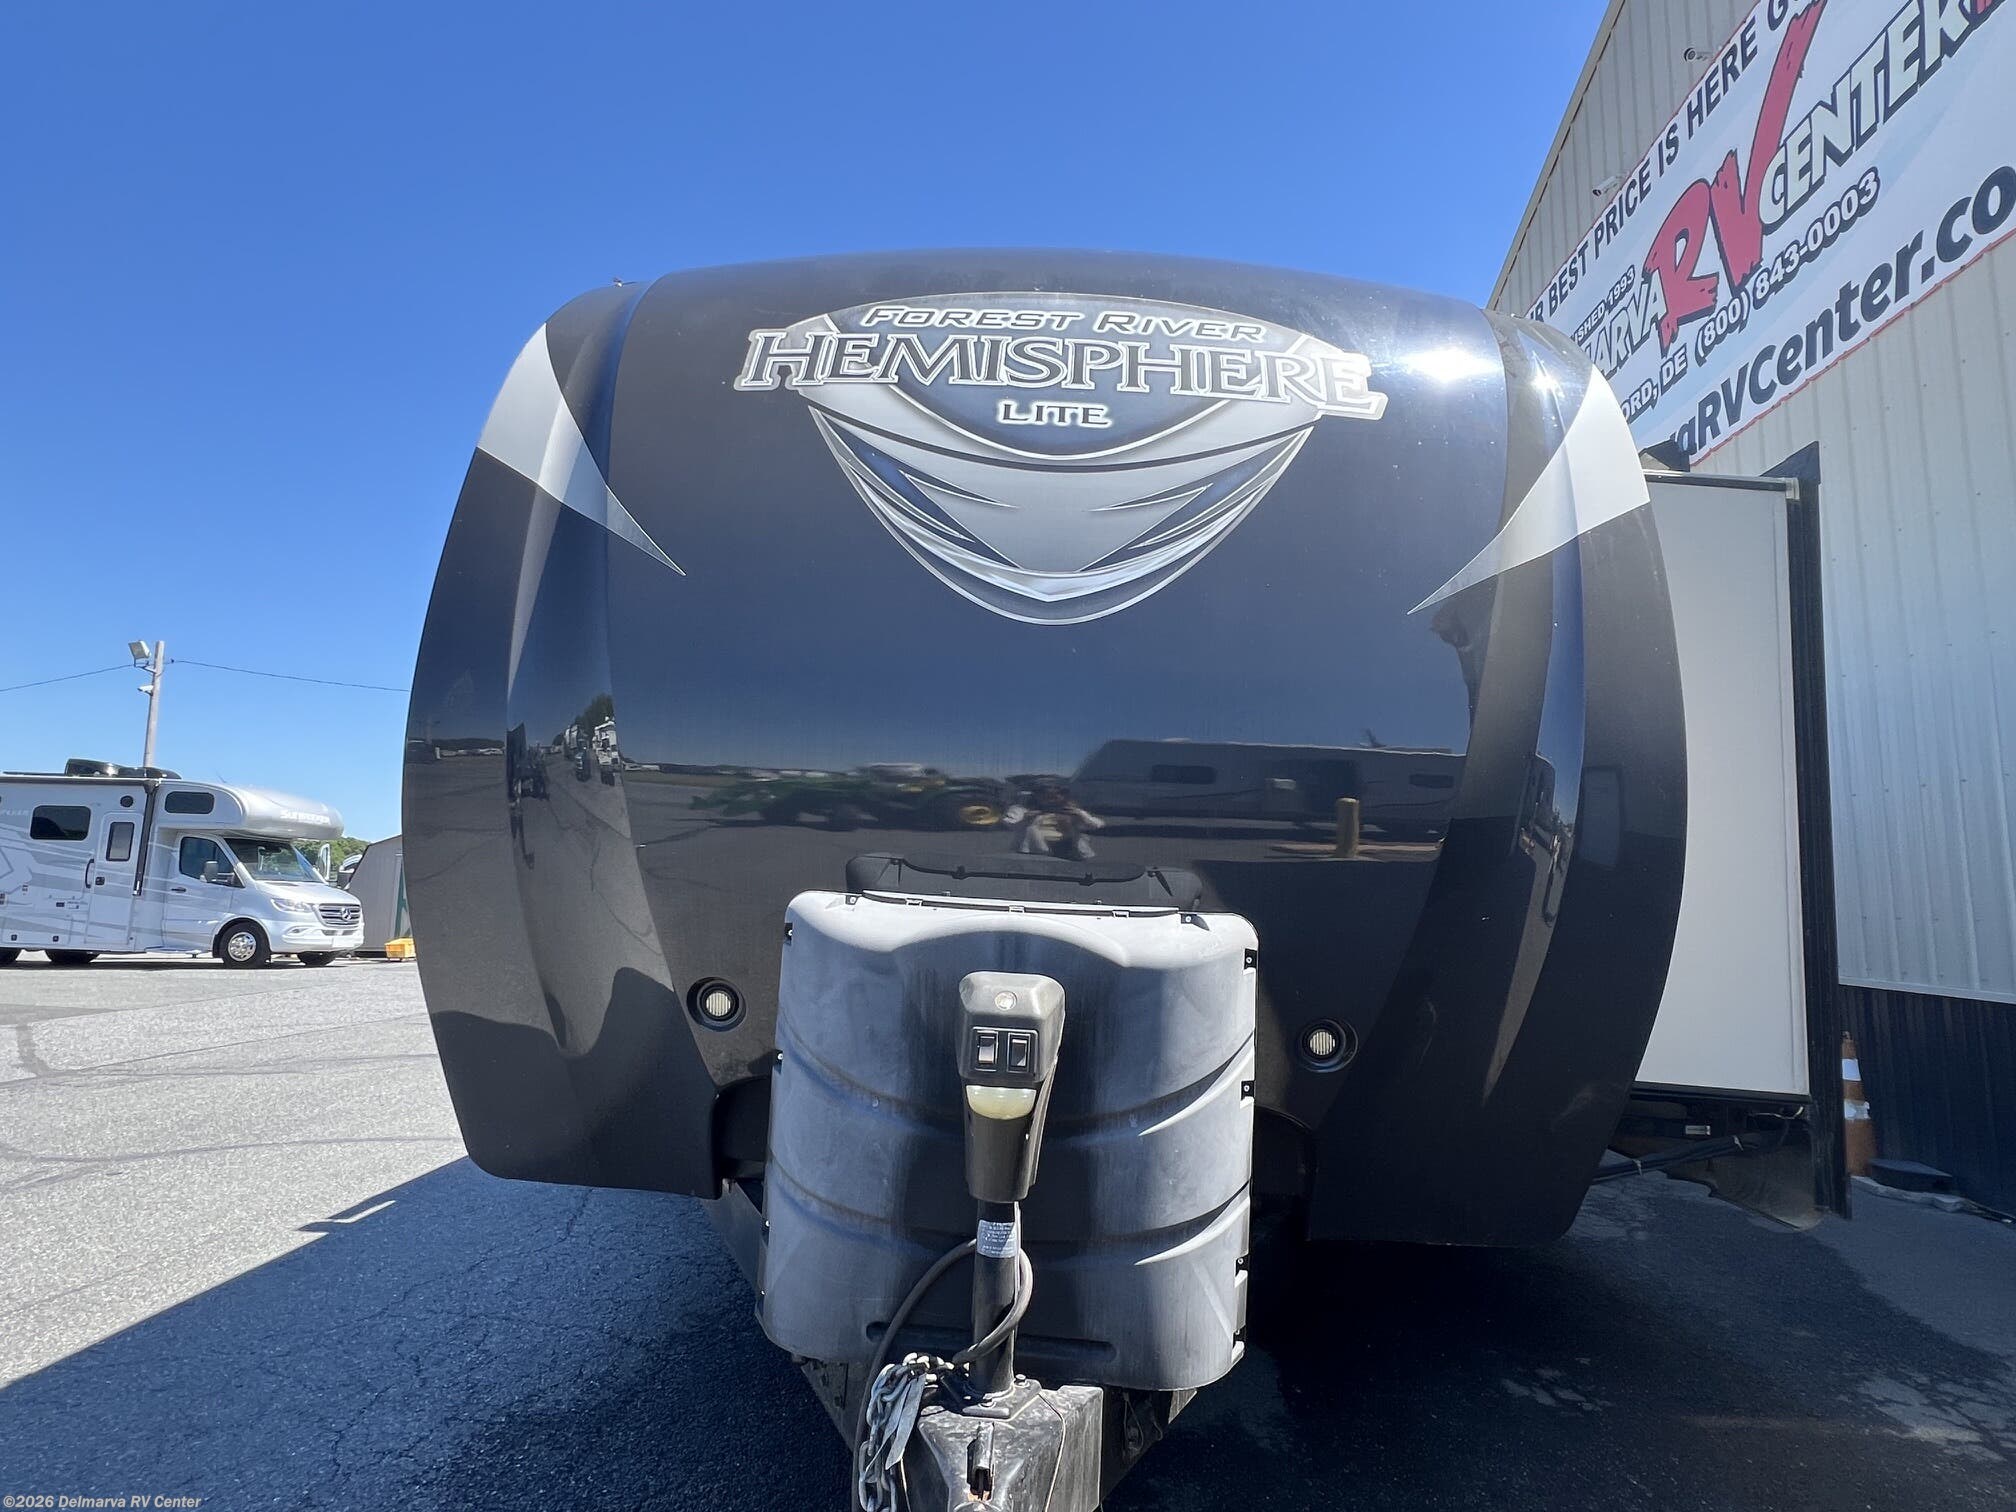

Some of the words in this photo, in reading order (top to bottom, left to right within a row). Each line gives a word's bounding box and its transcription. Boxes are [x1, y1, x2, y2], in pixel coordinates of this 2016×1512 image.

[1549, 240, 1589, 317] BEST
[1594, 157, 1652, 260] PRICE
[1658, 122, 1679, 178] IS
[1686, 15, 1758, 140] HERE
[1641, 0, 1826, 352] RV
[1758, 0, 1972, 236] CENTER
[861, 306, 1086, 331] FOREST
[1092, 311, 1267, 343] RIVER
[1606, 264, 1636, 314] 1993
[1660, 343, 1688, 396] DE
[1695, 287, 1749, 367] (800)
[1752, 166, 1880, 310] 843-0003
[1670, 166, 2016, 455] aRVCenter.co
[735, 330, 1387, 419] HEMISPHERE
[996, 401, 1112, 428] LITE
